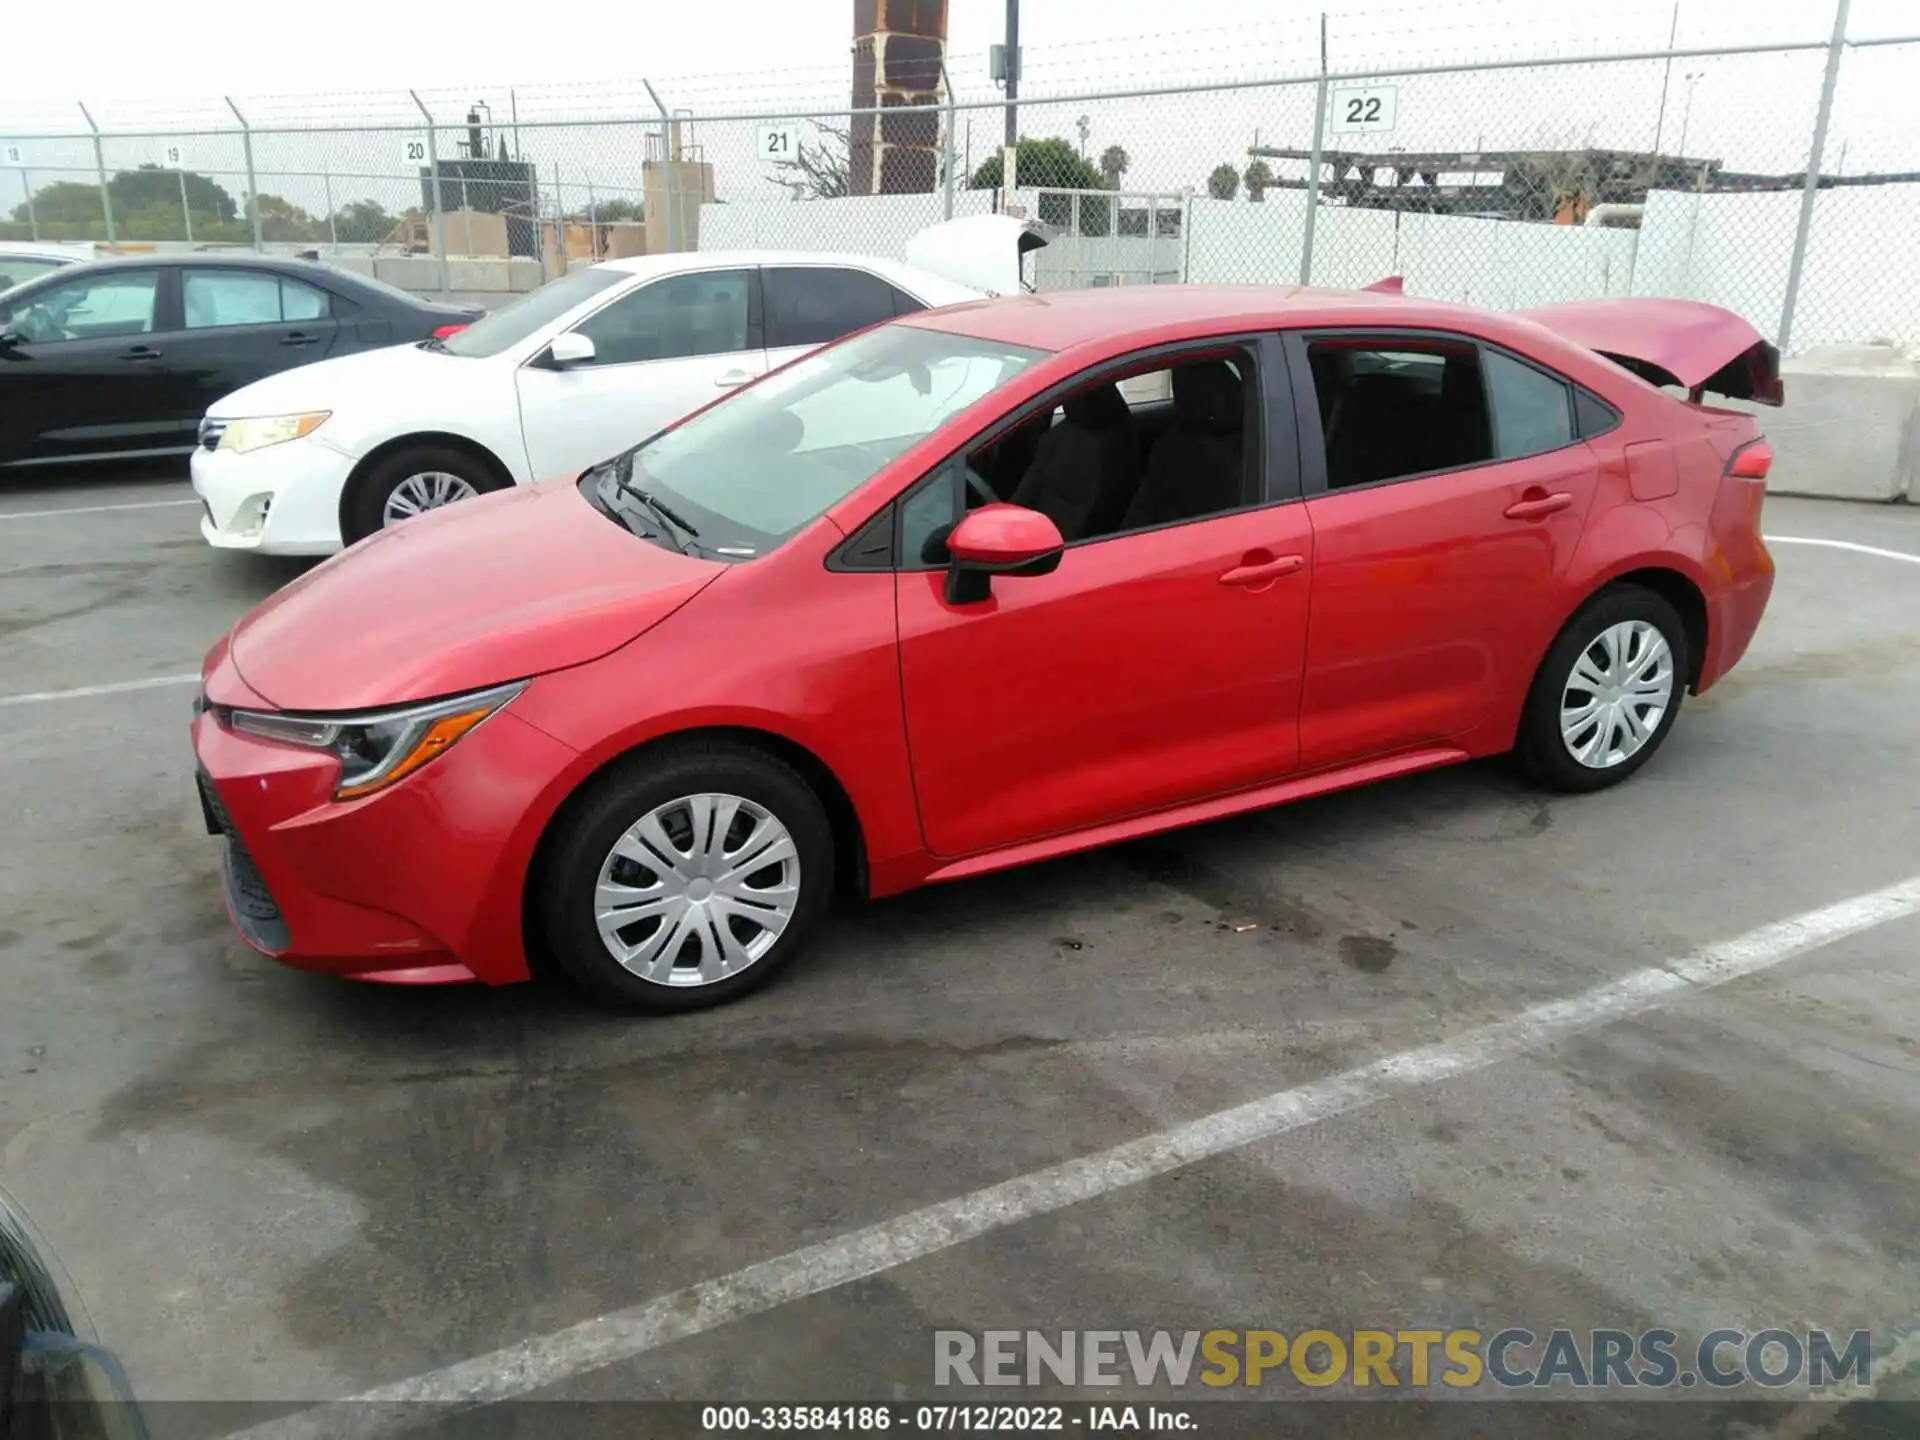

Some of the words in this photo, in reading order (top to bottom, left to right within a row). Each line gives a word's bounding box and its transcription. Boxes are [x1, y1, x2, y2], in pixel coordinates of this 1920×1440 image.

[1346, 97, 1381, 123] 22
[407, 142, 424, 159] 20
[768, 131, 788, 152] 21
[168, 146, 179, 162] 19
